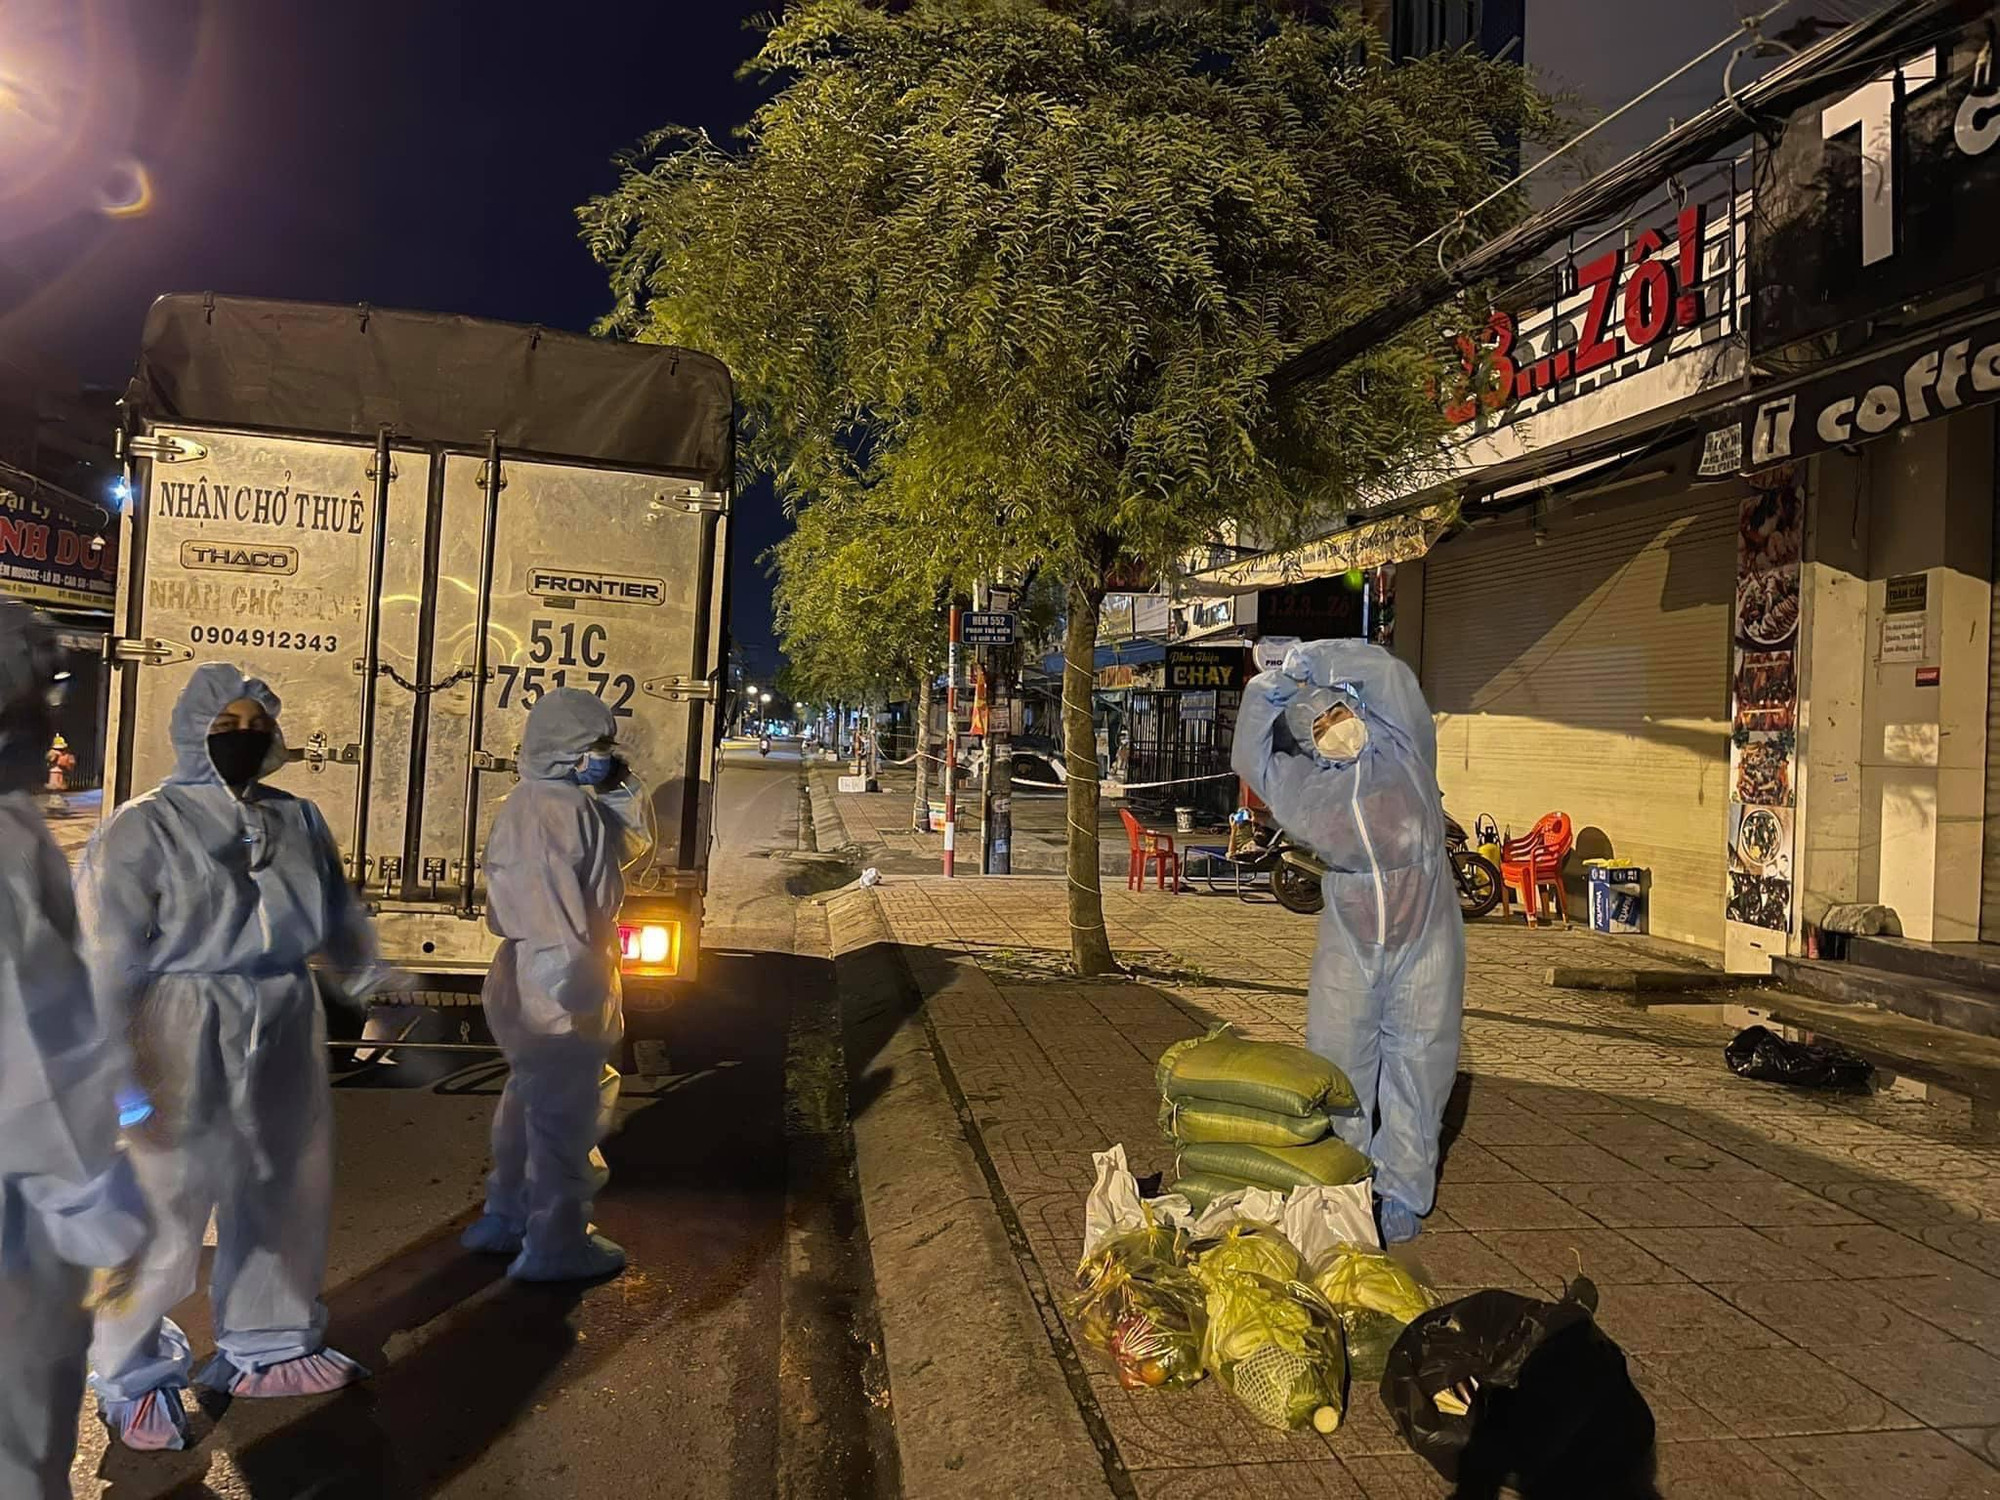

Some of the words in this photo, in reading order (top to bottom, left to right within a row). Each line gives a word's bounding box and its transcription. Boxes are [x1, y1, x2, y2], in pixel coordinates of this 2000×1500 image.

[158, 475, 230, 529] NHẬN
[234, 470, 293, 526] CHỞ
[294, 490, 365, 535] THUÊ
[190, 546, 289, 569] THACO
[534, 574, 659, 599] FRONTIER
[190, 625, 338, 653] 0904912343
[529, 619, 607, 668] 51C
[1173, 666, 1233, 686] CHAY
